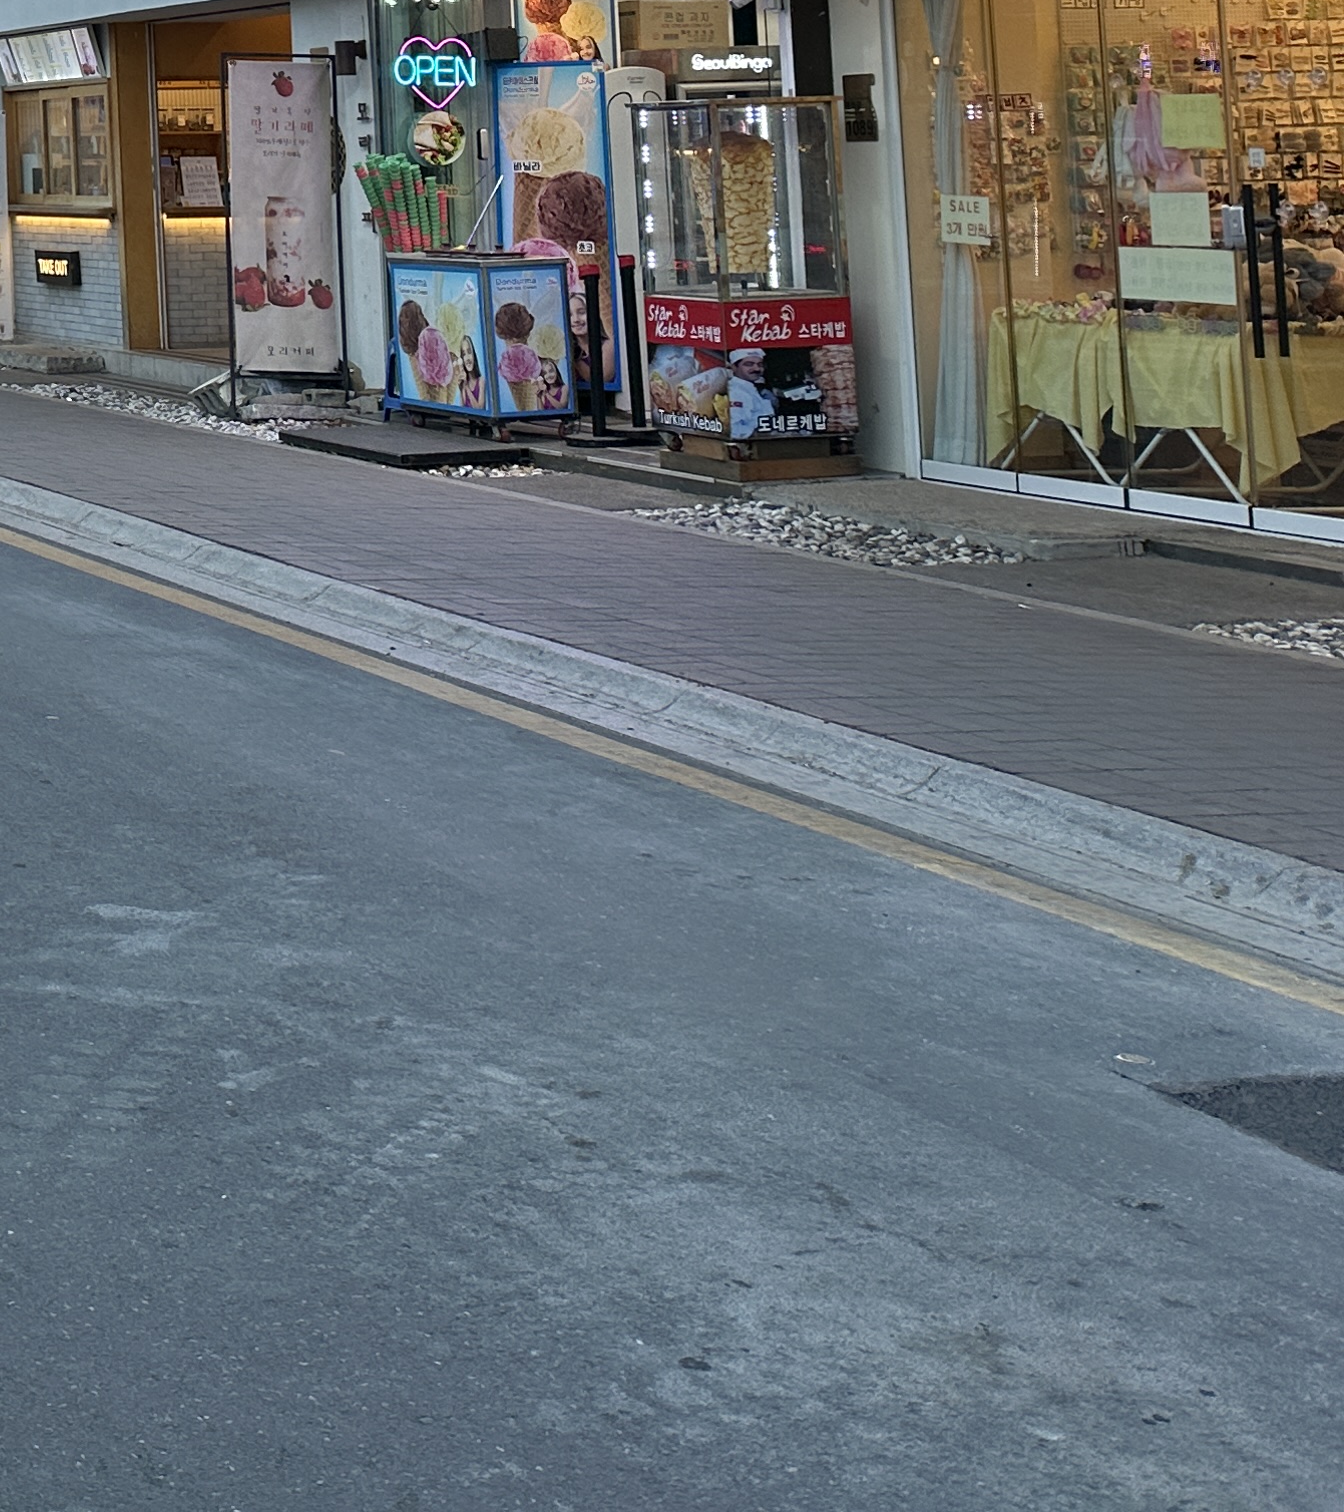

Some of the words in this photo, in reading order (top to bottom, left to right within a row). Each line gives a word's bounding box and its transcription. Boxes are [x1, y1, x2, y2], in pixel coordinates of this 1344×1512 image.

[394, 54, 476, 86] OPEN
[513, 161, 541, 171] 바닐라
[949, 199, 980, 214] SALE
[946, 222, 962, 236] 3개
[38, 258, 53, 275] TAKE
[54, 260, 68, 276] OUT
[648, 304, 673, 321] Star
[729, 308, 770, 328] Star
[655, 321, 686, 339] Kebab
[690, 325, 721, 343] 스타케밥
[741, 323, 792, 343] Kebab
[798, 321, 847, 339] 스타케밥
[659, 409, 690, 428] Turkish
[693, 414, 723, 433] Kebab
[758, 413, 828, 433] 도네르케밥
